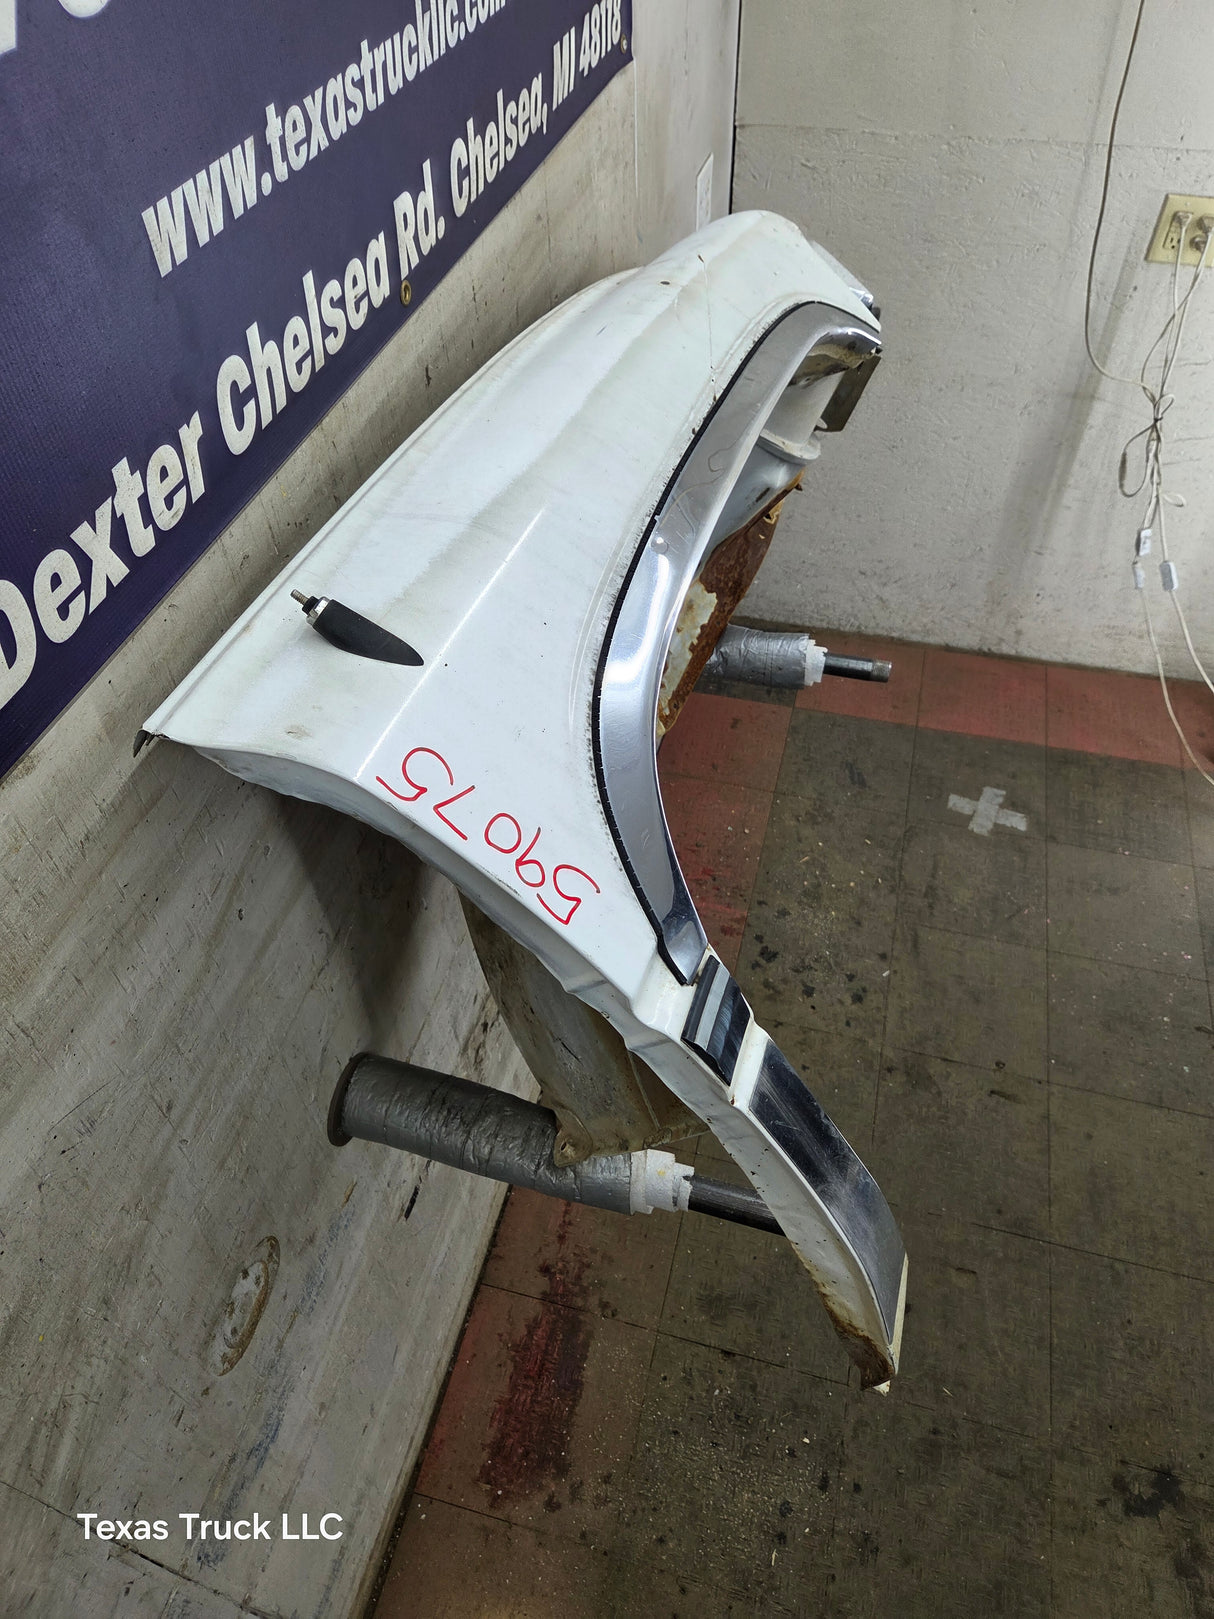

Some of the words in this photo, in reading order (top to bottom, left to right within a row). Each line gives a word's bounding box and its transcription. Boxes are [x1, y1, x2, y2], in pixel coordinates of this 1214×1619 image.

[0, 411, 206, 709] Dexter
[217, 230, 391, 455] Chelsea
[392, 158, 446, 281] Rd.
[449, 72, 548, 218] Chelsea,
[553, 26, 576, 112] MI
[579, 0, 622, 78] 48118
[375, 747, 600, 925] 59075
